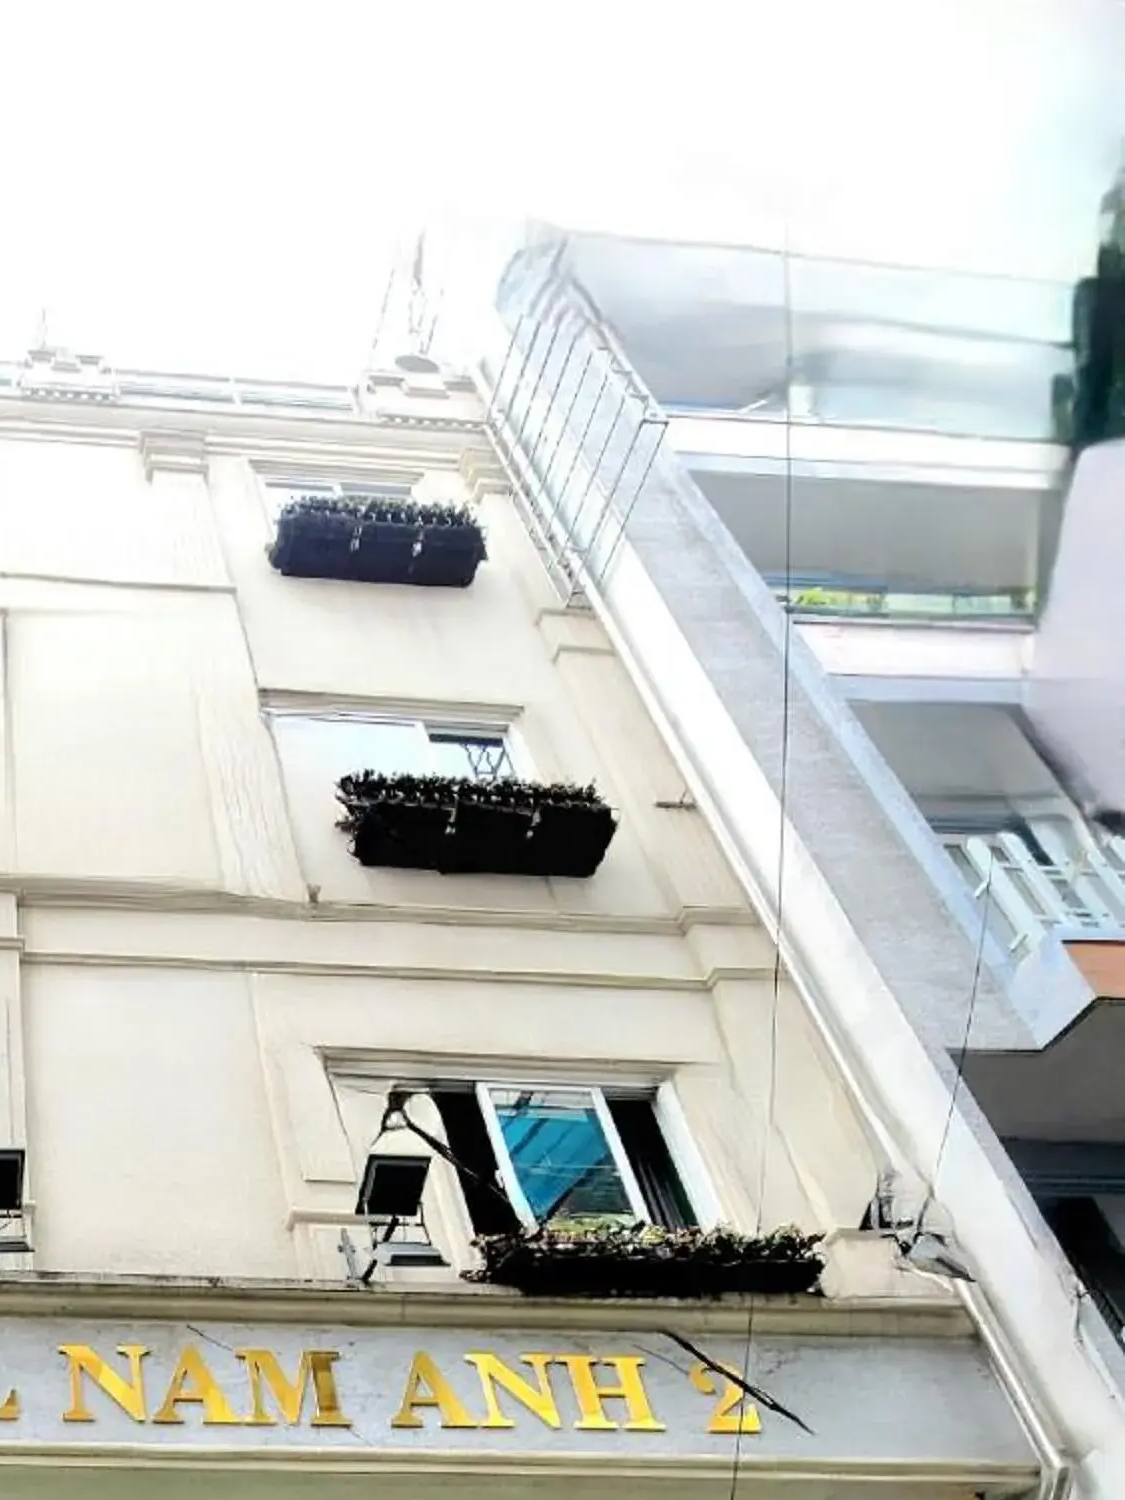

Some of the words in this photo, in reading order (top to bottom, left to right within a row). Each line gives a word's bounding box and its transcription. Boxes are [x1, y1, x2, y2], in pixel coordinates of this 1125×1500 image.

[58, 1344, 353, 1428] NAM
[391, 1350, 666, 1432] ANH
[688, 1360, 762, 1434] 2
